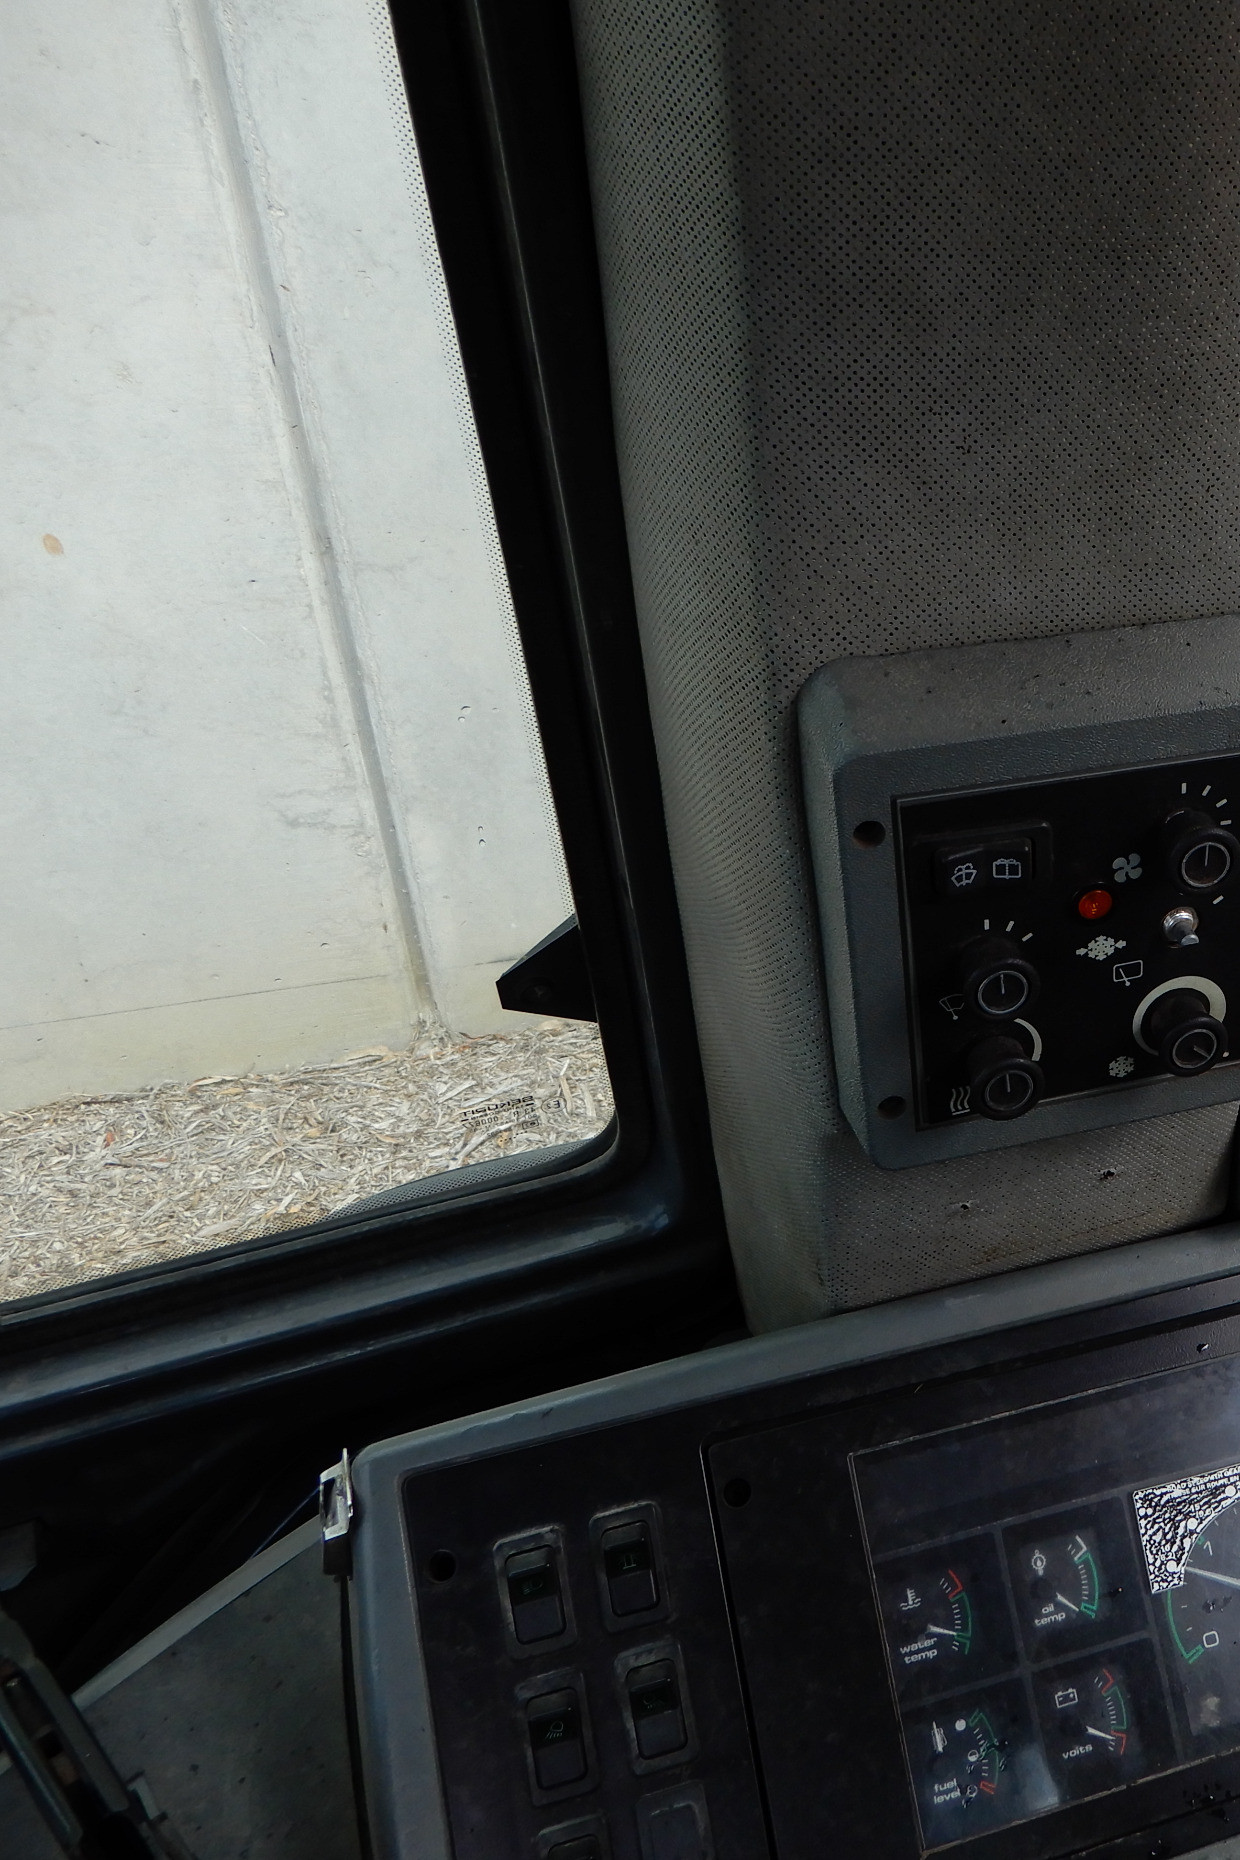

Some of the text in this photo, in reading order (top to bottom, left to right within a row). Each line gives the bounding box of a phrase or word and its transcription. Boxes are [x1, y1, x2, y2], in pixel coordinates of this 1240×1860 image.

[1034, 1610, 1066, 1626] temp
[1042, 1604, 1055, 1615] oil
[900, 1636, 937, 1654] water
[904, 1648, 938, 1664] temp
[1062, 1743, 1094, 1760] volts
[934, 1778, 957, 1795] fuel
[933, 1787, 961, 1805] level
